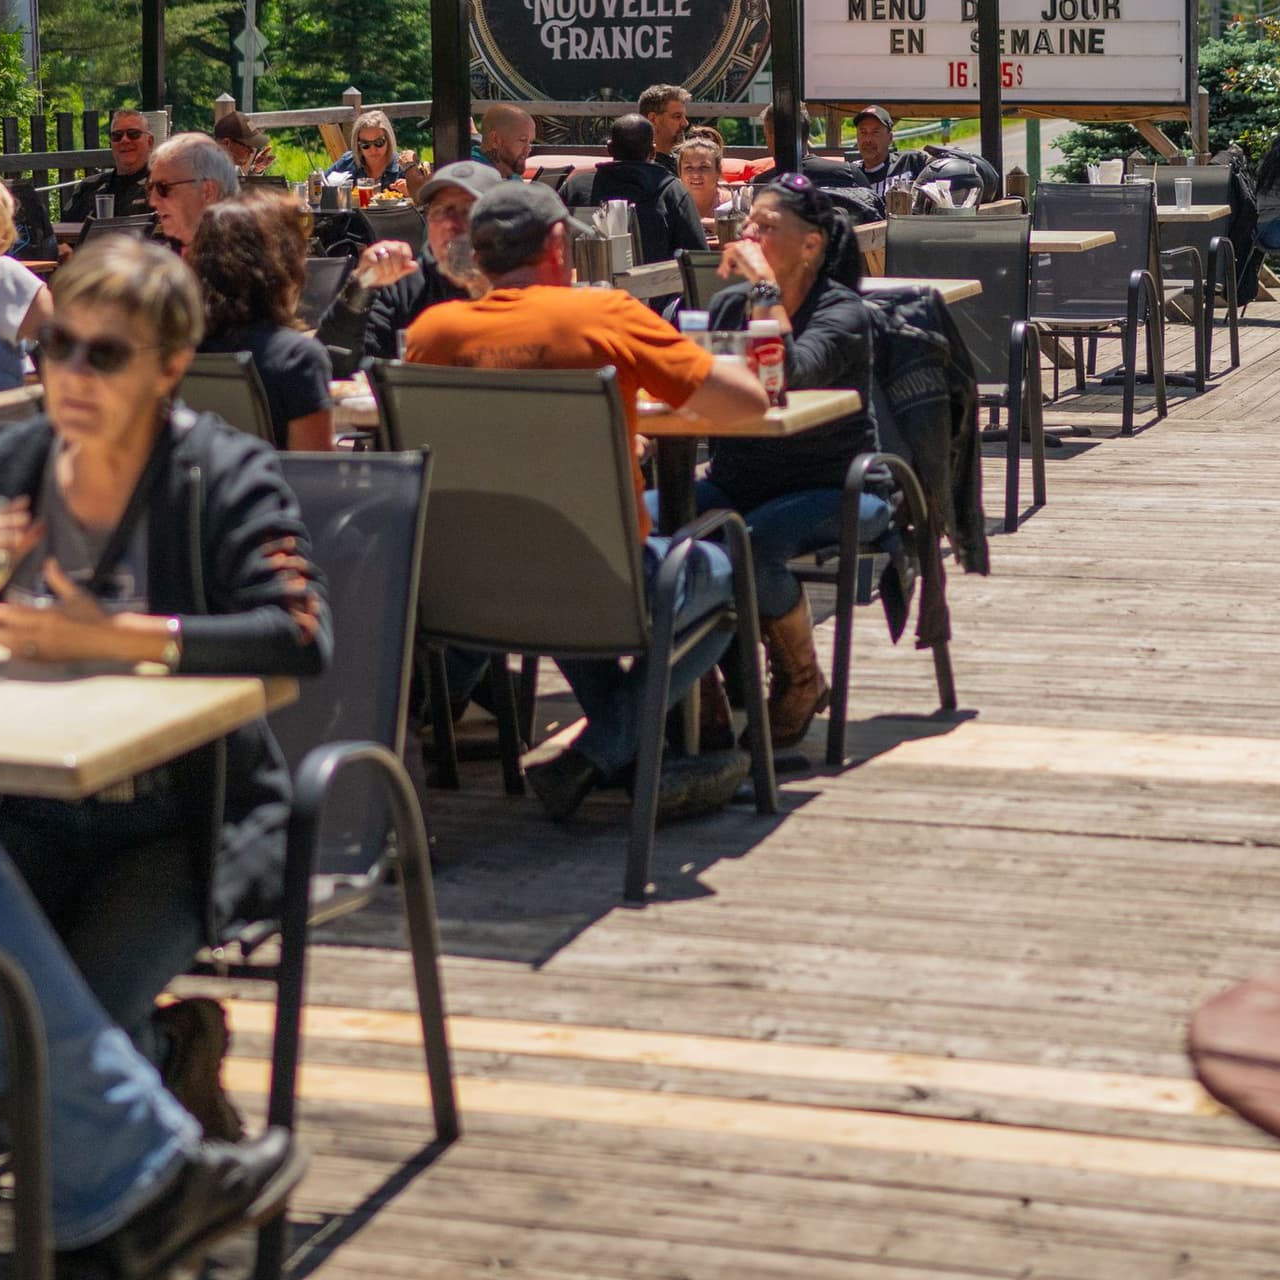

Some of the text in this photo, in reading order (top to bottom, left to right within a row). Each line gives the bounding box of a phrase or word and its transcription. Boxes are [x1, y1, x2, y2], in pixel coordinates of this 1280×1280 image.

[540, 16, 673, 61] FRANCE
[890, 28, 925, 54] EN
[948, 61, 1023, 88] 16.5$
